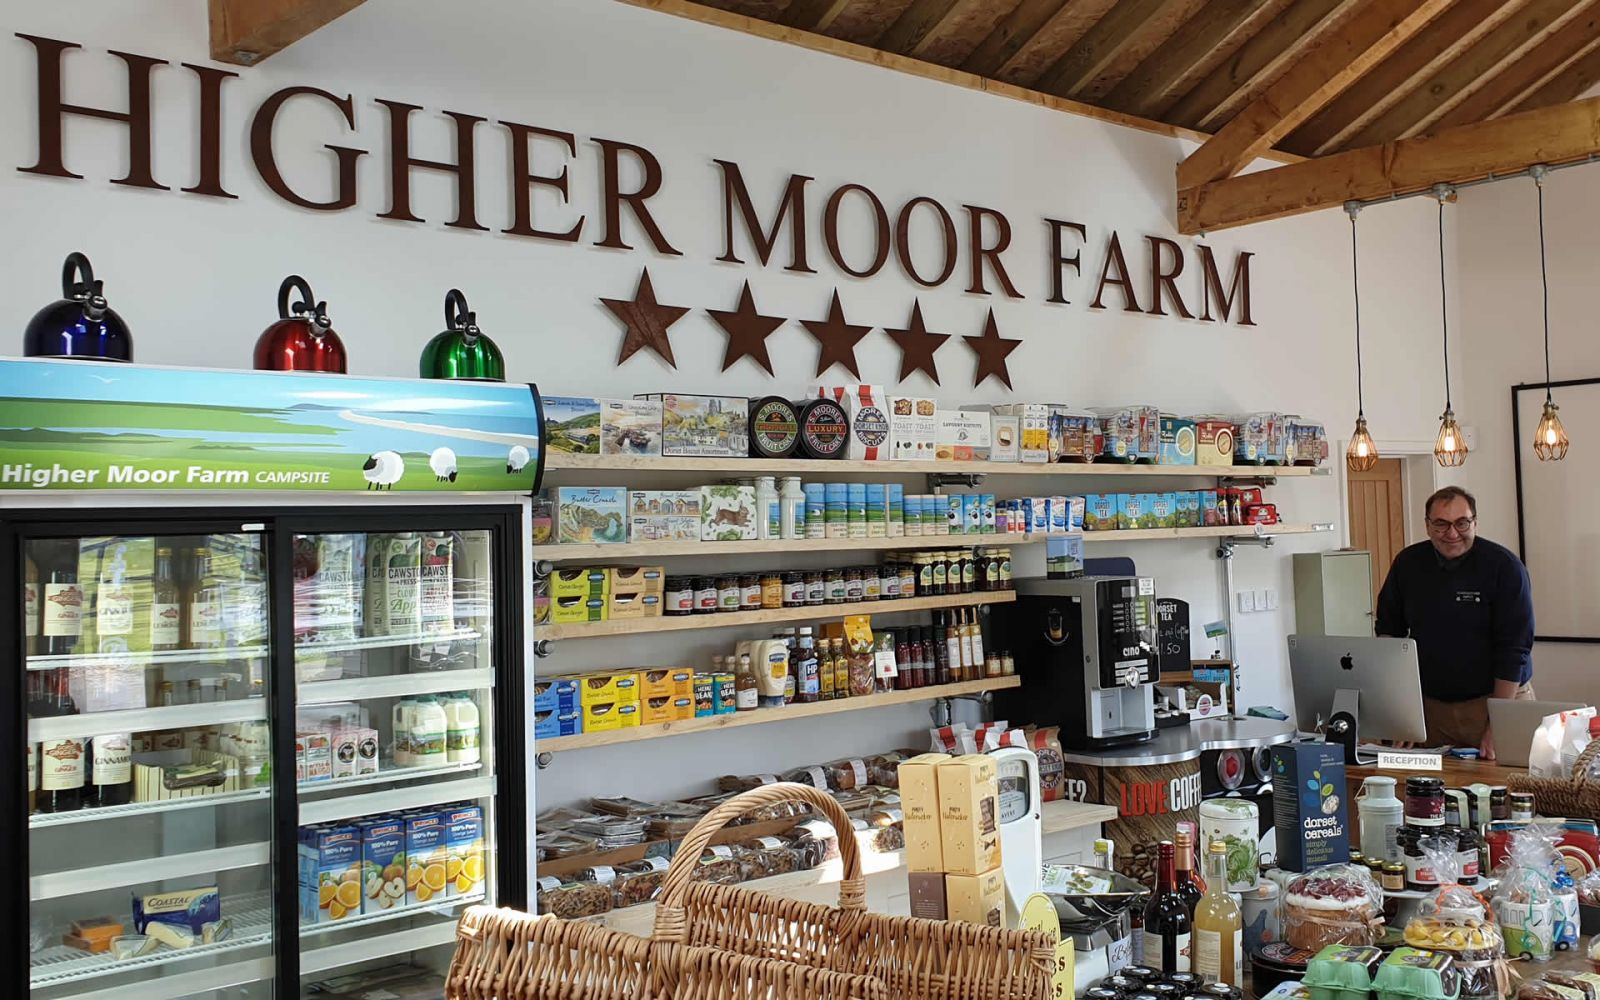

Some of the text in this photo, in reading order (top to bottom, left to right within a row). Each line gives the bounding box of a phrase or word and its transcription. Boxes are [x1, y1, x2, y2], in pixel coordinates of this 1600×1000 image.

[14, 33, 1257, 327] HIGHER MOOR FARM
[858, 407, 885, 423] MOORES
[808, 425, 844, 433] LUXURY
[758, 433, 794, 451] FRUIT CAKE
[809, 434, 843, 452] FRUIT CAKE
[857, 431, 887, 447] BISCUITS
[1, 464, 330, 487] Higher Moor Farm CAMPSITE
[1099, 510, 1107, 519] TEA
[422, 566, 448, 577] CAWST
[391, 598, 416, 614] App
[1156, 604, 1178, 613] DORSET
[1160, 613, 1173, 621] TEA
[807, 664, 818, 674] HP
[1382, 755, 1438, 766] RECEPTION
[1120, 779, 1168, 817] LOVE
[1304, 815, 1338, 828] dorset
[451, 824, 465, 832] 100%
[1304, 825, 1342, 840] cereals
[412, 830, 439, 840] 100% Pure
[371, 839, 399, 849] 100% Pure
[1306, 840, 1328, 848] simply
[147, 895, 192, 908] COASTAL
